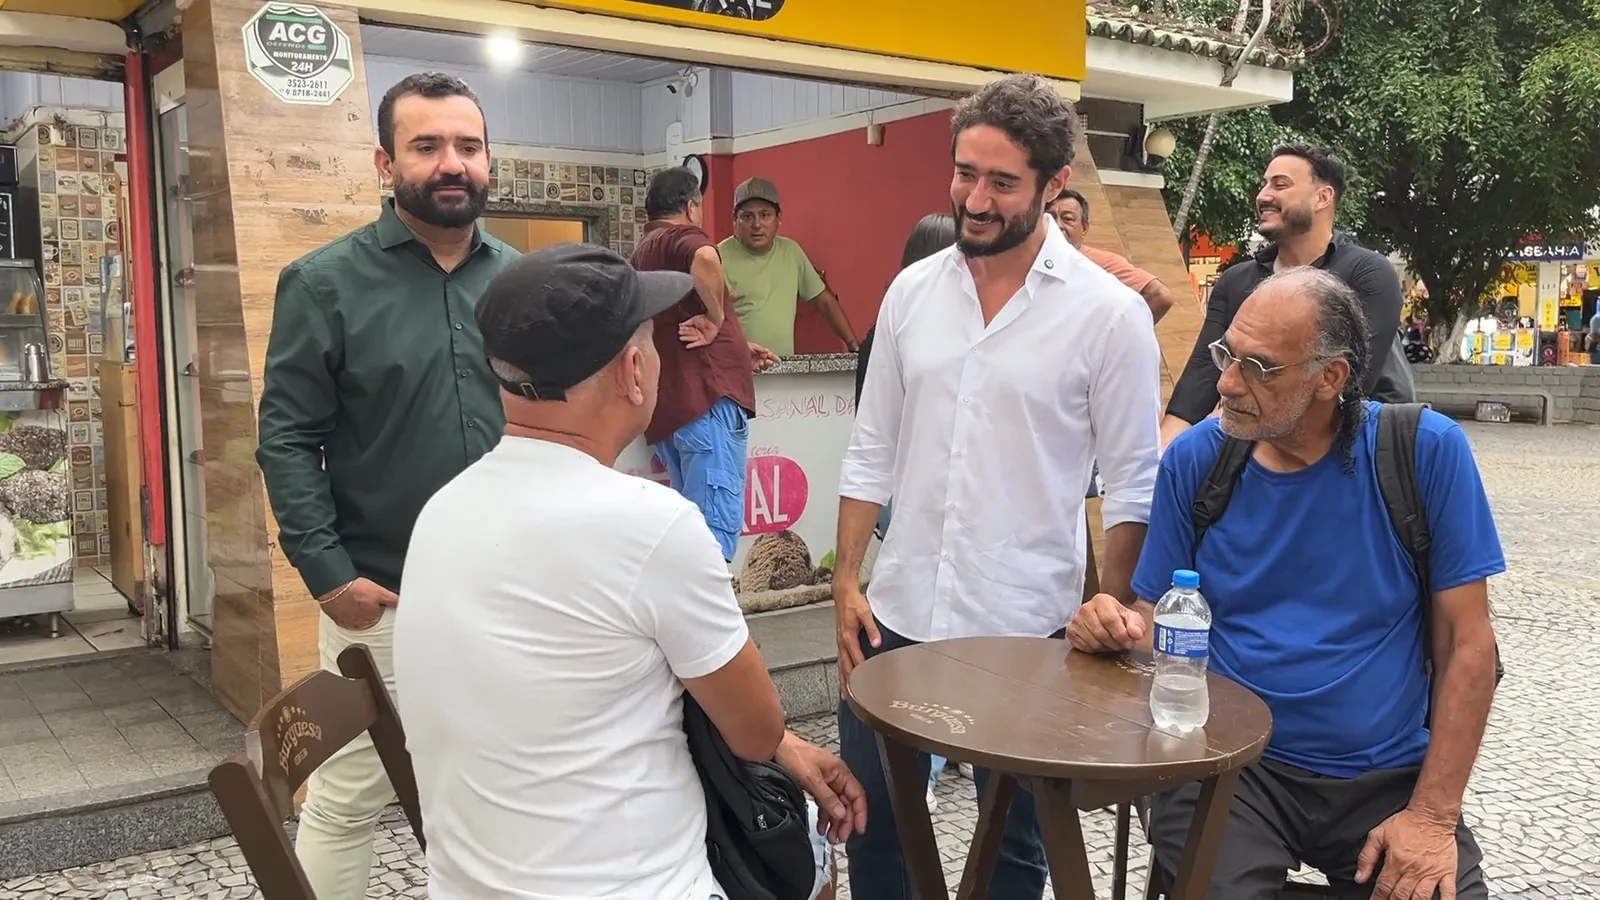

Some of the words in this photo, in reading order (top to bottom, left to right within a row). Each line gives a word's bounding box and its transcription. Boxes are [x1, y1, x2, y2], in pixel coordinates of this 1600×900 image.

[268, 21, 326, 44] ACG
[273, 51, 328, 61] MONITORAMENTO
[291, 61, 314, 72] 24H
[287, 79, 328, 89] 3523-2611
[742, 465, 788, 533] AL
[279, 721, 323, 776] Burguesa
